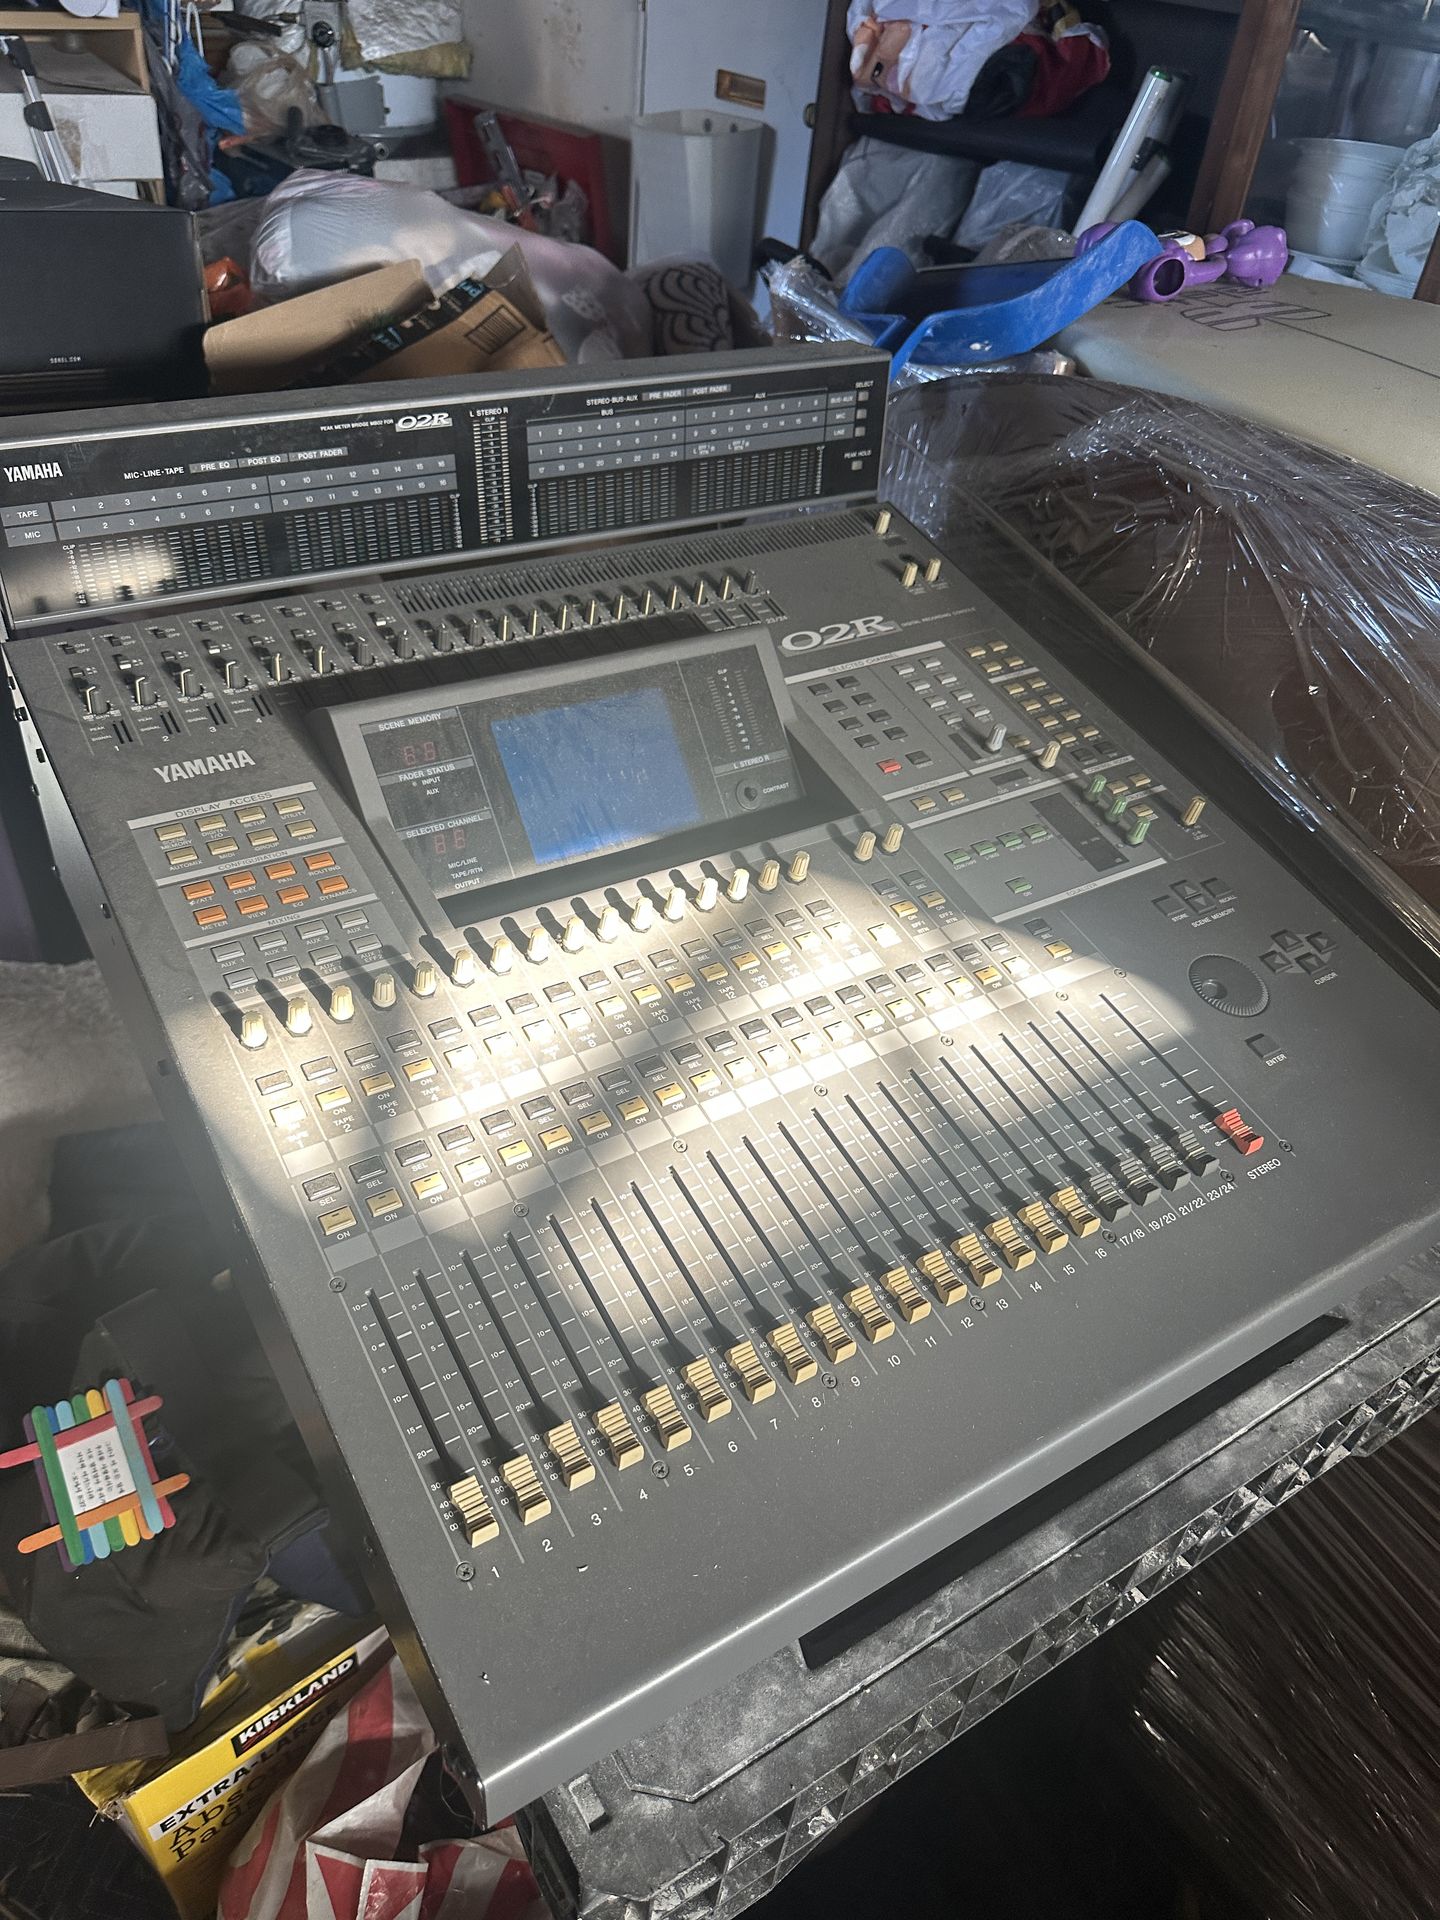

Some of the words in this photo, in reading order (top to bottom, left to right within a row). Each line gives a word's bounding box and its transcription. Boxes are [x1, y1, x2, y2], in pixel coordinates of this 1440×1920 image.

[663, 390, 682, 398] FADER
[709, 385, 728, 393] FADER
[476, 408, 501, 416] STEREO
[298, 451, 318, 460] POST
[320, 448, 343, 457] FADER
[201, 462, 215, 470] PRE
[219, 461, 230, 469] EQ
[248, 457, 269, 465] POST
[270, 455, 281, 463] EQ
[4, 462, 63, 482] YAMAHA
[17, 510, 38, 519] TAPE
[280, 479, 286, 487] 9
[25, 531, 40, 539] MIC
[378, 721, 405, 732] SCENE
[408, 713, 441, 726] MEMORY
[153, 750, 256, 784] YAMAHA
[740, 757, 763, 767] STEREO
[399, 771, 424, 782] FADER
[427, 764, 455, 775] STATUS
[422, 776, 440, 786] INPUT
[426, 788, 439, 796] AUX
[763, 783, 789, 794] CONTRAST
[175, 803, 221, 818] DISPLAY
[229, 792, 273, 807] ACCESS
[281, 811, 307, 820] UTILITY
[406, 823, 445, 838] SELECTED
[447, 814, 482, 828] CHANNEL
[201, 827, 229, 837] DIGITAL
[160, 839, 192, 850] MEMORY
[254, 842, 280, 851] GROUP
[169, 860, 203, 871] AUTOMIX
[218, 850, 288, 871] CONFIGURATION
[448, 857, 478, 868] MIC/LINE
[308, 865, 341, 877] ROUTING
[451, 867, 484, 880] TAPE/RTN
[455, 878, 480, 889] OUTPUT
[233, 886, 256, 895] DELAY
[319, 888, 357, 901] DYNAMICS
[248, 911, 266, 919] VIEW
[267, 913, 300, 927] MIXING
[1171, 913, 1189, 922] STORE
[1192, 916, 1209, 928] SCENE
[1210, 907, 1235, 920] MEMORY
[201, 921, 228, 931] METER
[346, 927, 363, 935] AUX
[306, 937, 322, 946] AUX
[264, 948, 280, 957] AUX
[221, 959, 237, 968] AUX
[1314, 972, 1338, 985] CURSOR
[1266, 1054, 1287, 1067] ENTER
[491, 1566, 500, 1578] 1
[542, 1539, 553, 1552] 2
[591, 1513, 602, 1525] 3
[638, 1489, 648, 1500] 4
[683, 1464, 694, 1476] 5
[728, 1441, 738, 1453] 6
[770, 1419, 778, 1430] 7
[811, 1397, 821, 1408] 8
[851, 1376, 860, 1387] 9
[887, 1355, 900, 1367] 10
[924, 1336, 937, 1347] 11
[961, 1317, 974, 1328] 12
[996, 1299, 1008, 1310] 13
[1029, 1281, 1042, 1293] 14
[1062, 1264, 1075, 1276] 15
[1095, 1248, 1107, 1259] 16
[1119, 1228, 1145, 1247] 17/18
[1148, 1212, 1177, 1231] 19/20
[1178, 1197, 1206, 1216] 21/22
[1206, 1183, 1235, 1201] 23/24
[1247, 1159, 1281, 1180] STEREO
[239, 1658, 354, 1744] KIRKLAND
